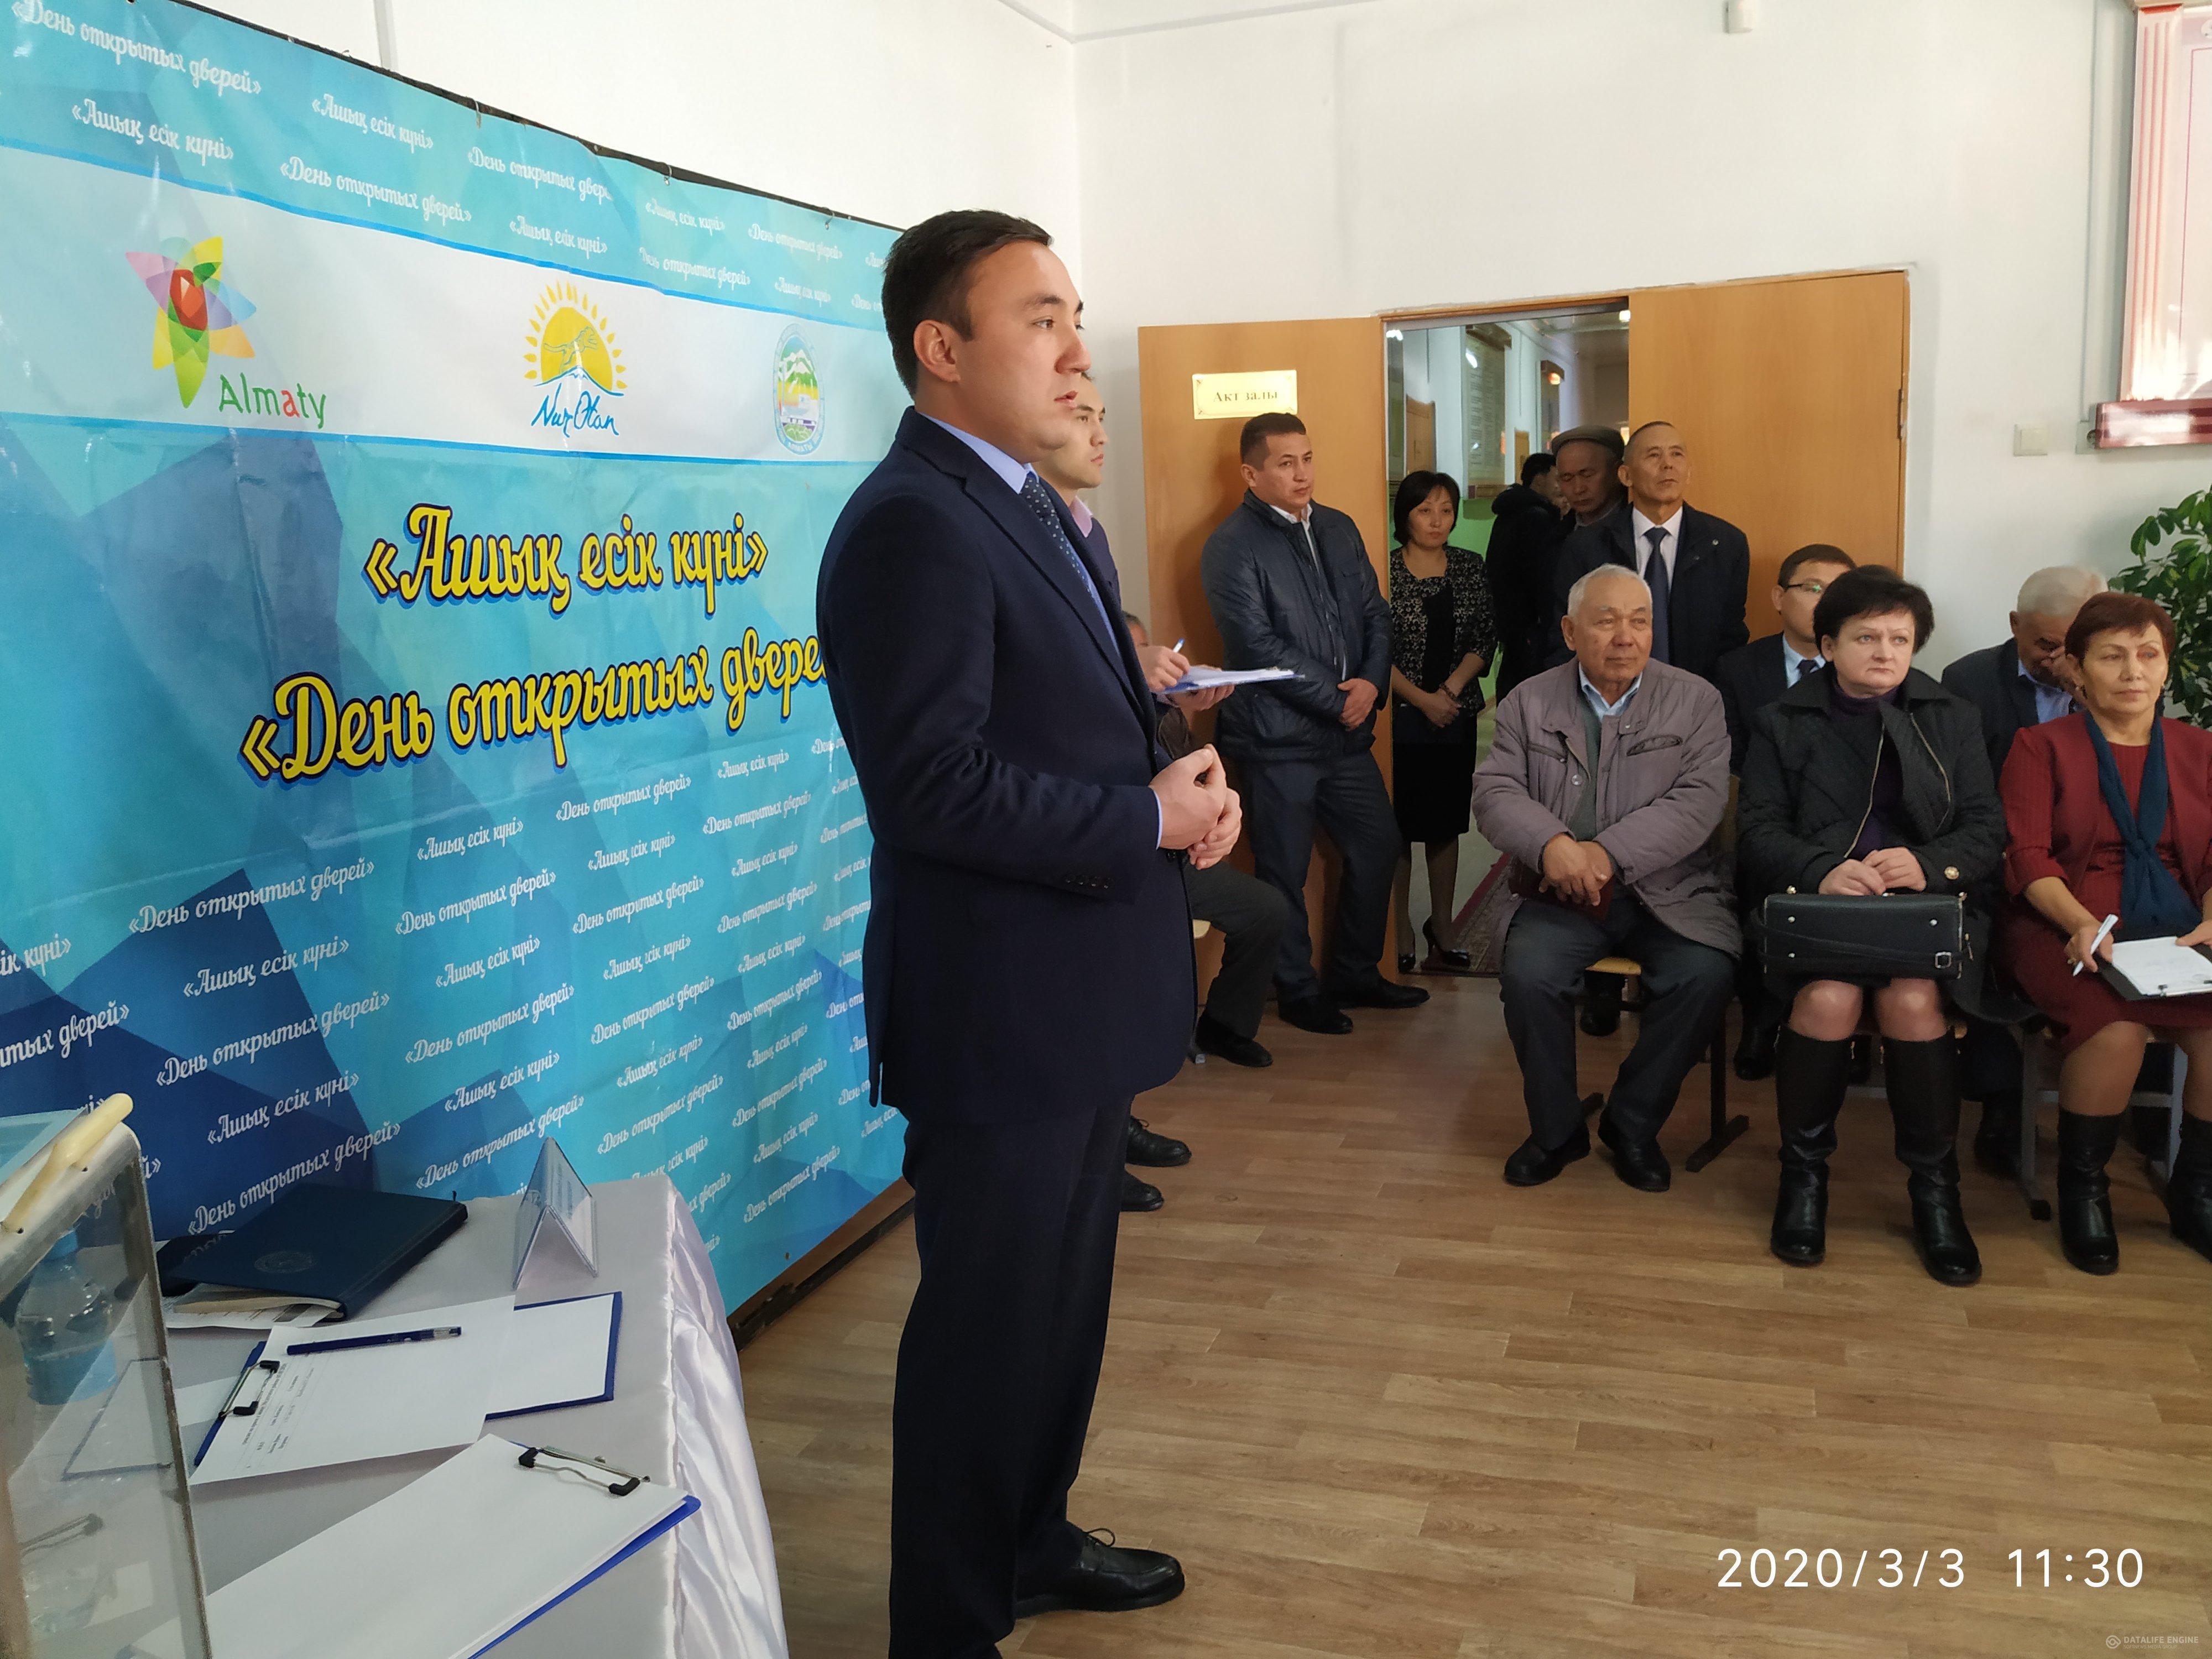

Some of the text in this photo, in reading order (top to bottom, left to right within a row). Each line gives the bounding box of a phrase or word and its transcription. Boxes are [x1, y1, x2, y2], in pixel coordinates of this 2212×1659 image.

[12, 0, 261, 96] «День открытых дверей»
[71, 98, 233, 166] «Ашық есік күні»
[312, 93, 432, 154] «Ашық есік күні»
[280, 156, 471, 226] «День открытых дверей»
[468, 147, 505, 173] «День
[510, 161, 575, 189] открытых
[218, 372, 326, 429] Almaty
[531, 383, 619, 438] Nur Otan
[1213, 392, 1239, 402] Акт
[362, 503, 769, 617] «Ашық есік күні»
[239, 627, 827, 782] «День открытых двере
[556, 773, 691, 821] «День открытых дверей»
[703, 790, 811, 834] «День открытых дверей»
[417, 817, 524, 860] «Ашық есік күні»
[128, 857, 374, 933] «День открытых дверей»
[395, 868, 556, 935] «День открытых дверей»
[572, 875, 704, 934] «День открытых дверей»
[23, 933, 71, 977] күні»
[183, 936, 349, 997] «Ашық есік күні»
[436, 935, 540, 987] «Ашық есік күні»
[59, 1000, 129, 1058] дверей»
[156, 991, 390, 1087] «День открытых дверей»
[405, 983, 574, 1063] «День открытых дверей»
[591, 976, 714, 1044] «День открытых дверей»
[727, 1011, 752, 1031] «День
[207, 1071, 359, 1144] «Ашық есік күні»
[445, 1050, 560, 1112] «Ашық есік күні»
[416, 1094, 584, 1189] «День открытых дверей»
[598, 1074, 723, 1154] «День открытых дверей»
[188, 1120, 400, 1235] «День открытых дверей»
